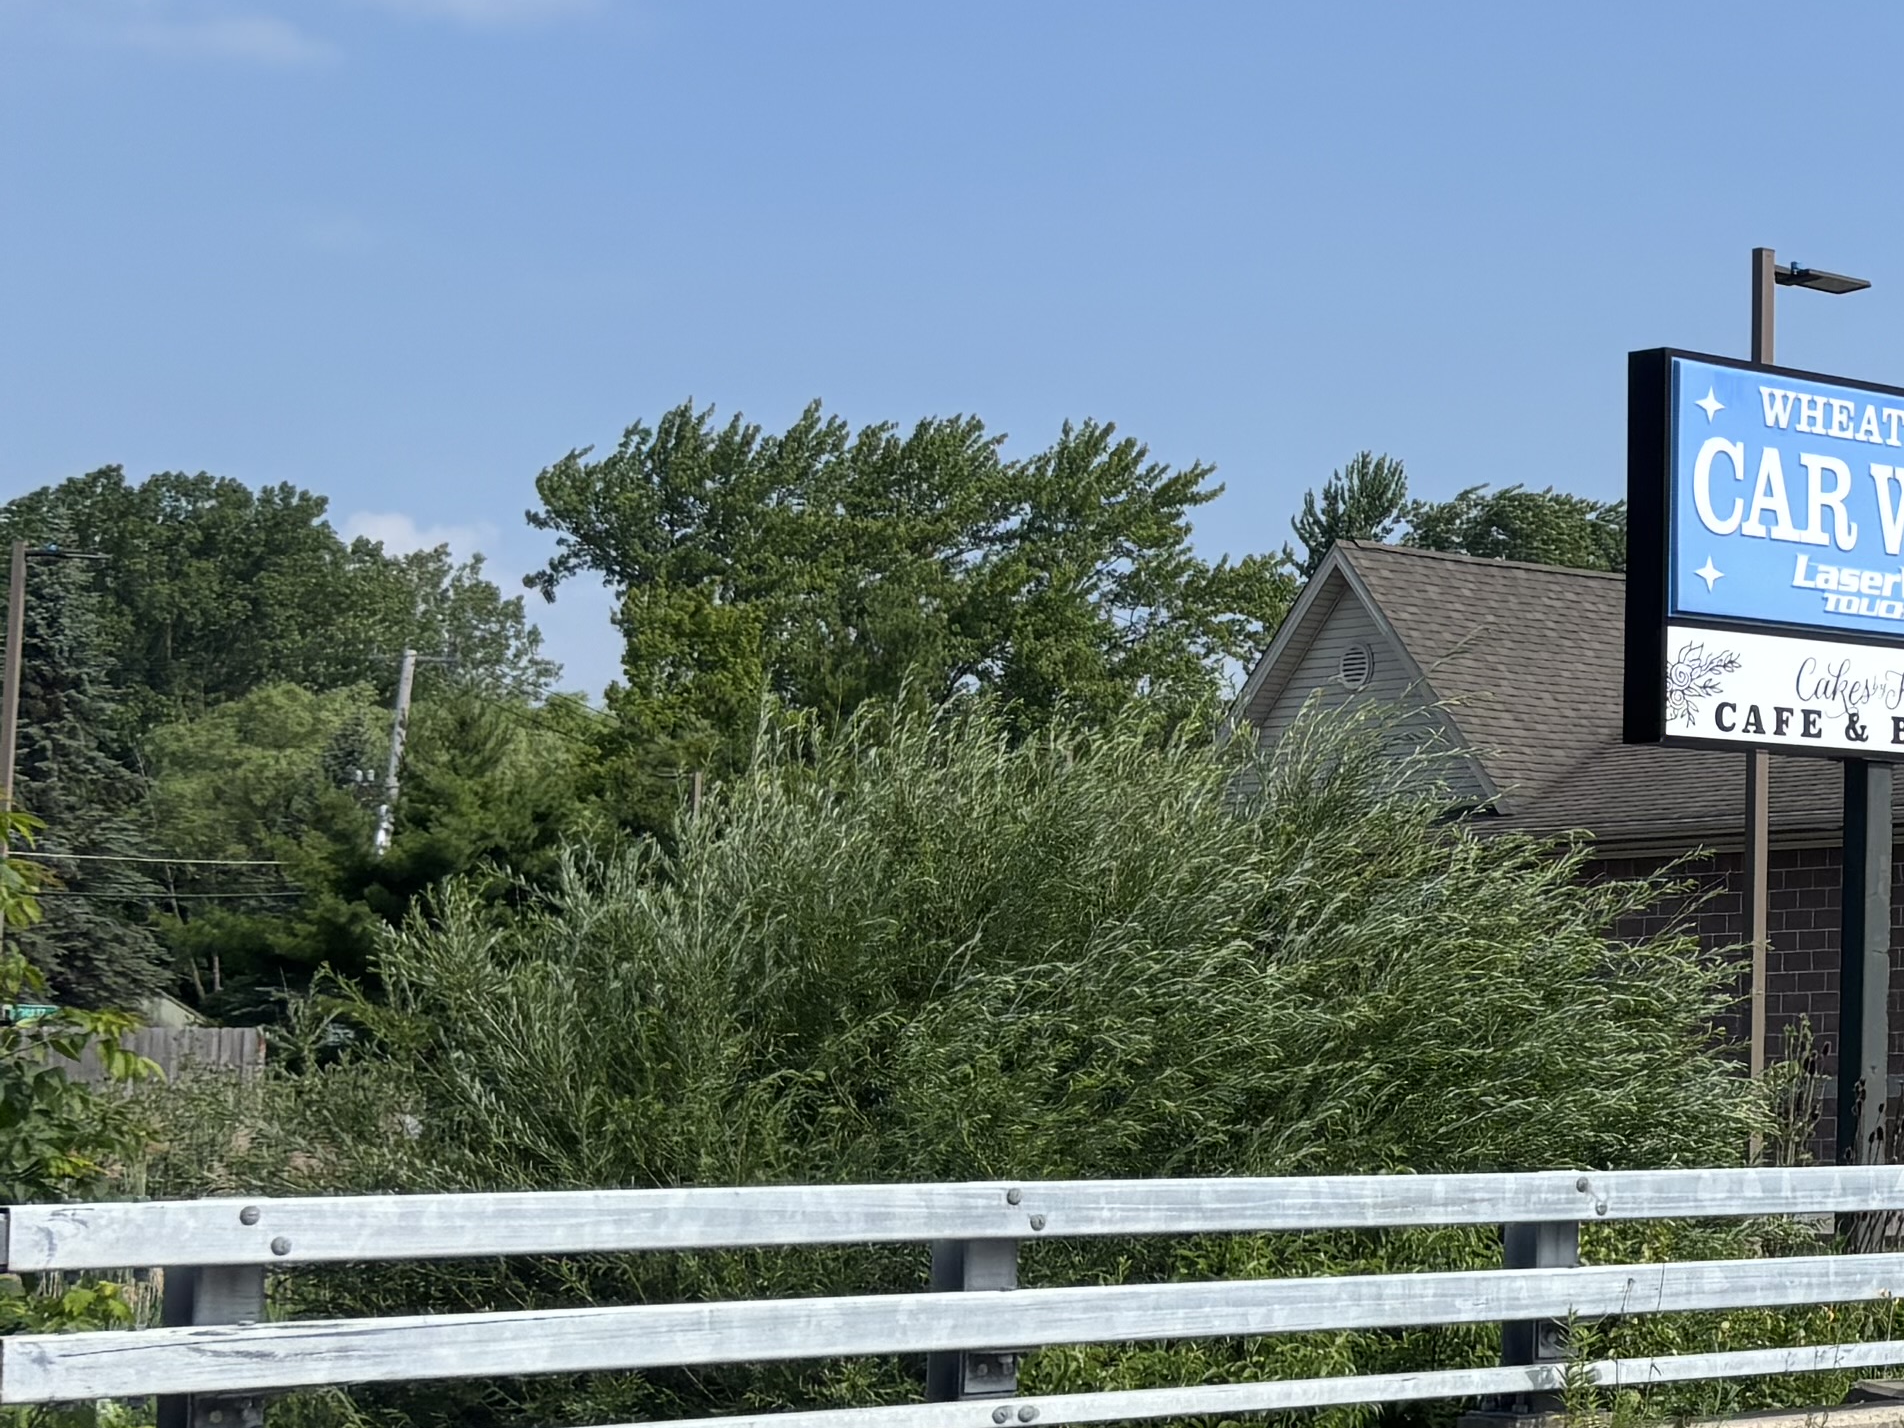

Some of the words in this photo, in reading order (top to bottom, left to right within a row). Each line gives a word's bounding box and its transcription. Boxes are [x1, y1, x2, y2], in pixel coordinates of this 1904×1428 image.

[1692, 436, 1858, 552] CAR
[1796, 657, 1870, 712] Cakes
[1870, 675, 1887, 699] by
[1714, 701, 1823, 739] CAFE
[1844, 712, 1869, 742] &
